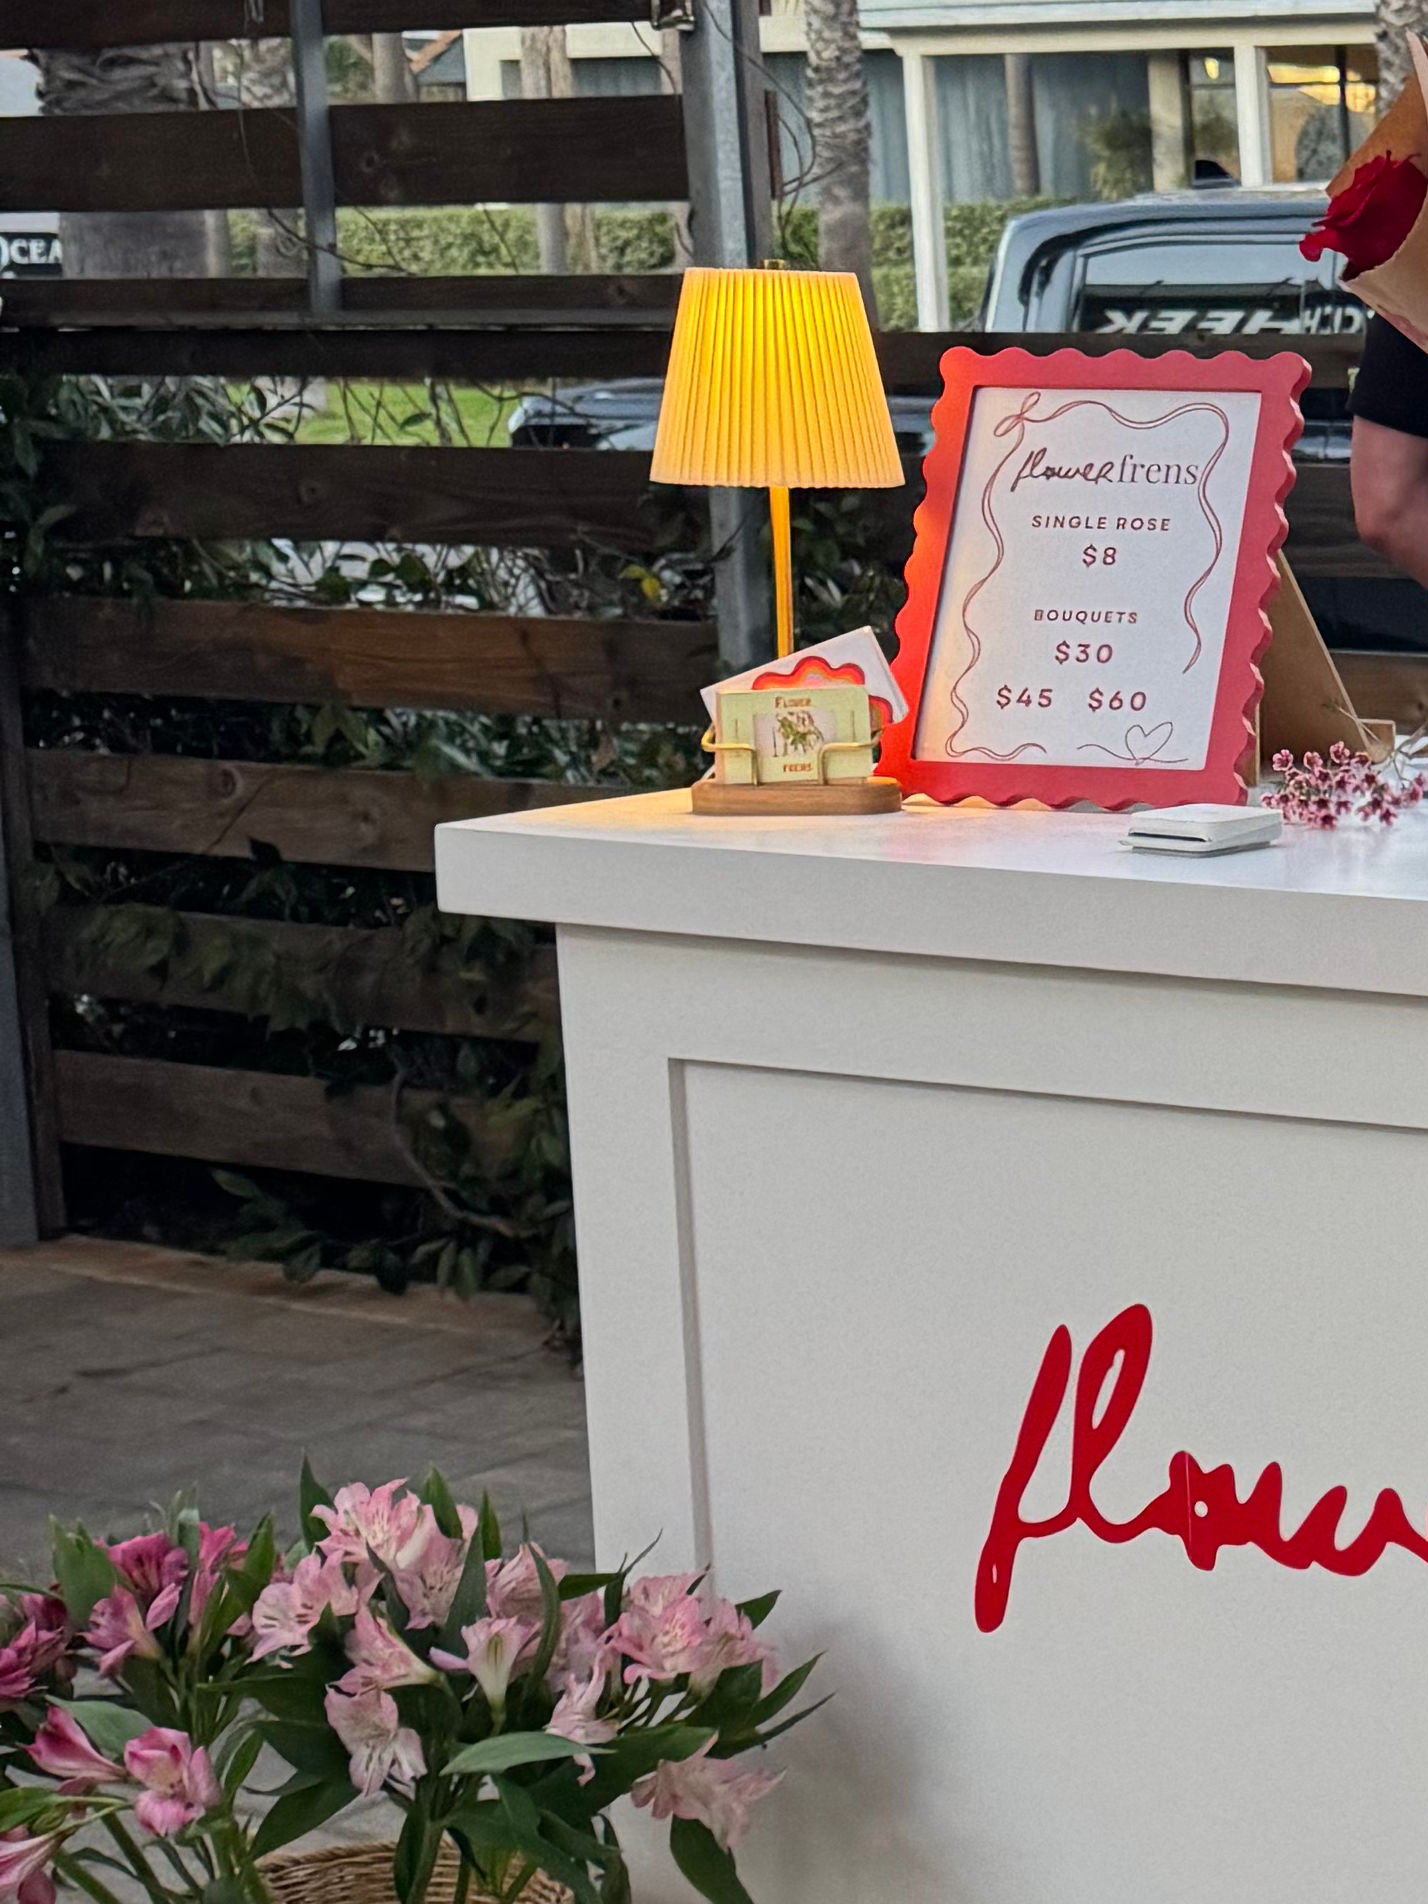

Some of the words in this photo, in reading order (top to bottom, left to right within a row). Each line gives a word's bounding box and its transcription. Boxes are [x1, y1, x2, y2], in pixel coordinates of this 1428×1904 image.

[1031, 514, 1108, 530] SINGLE
[1116, 517, 1171, 532] ROSE
[1082, 544, 1117, 568] $8
[1033, 608, 1139, 625] BOUQUETS
[1054, 640, 1113, 665] $30
[995, 684, 1053, 710] $45
[1087, 687, 1147, 713] $60
